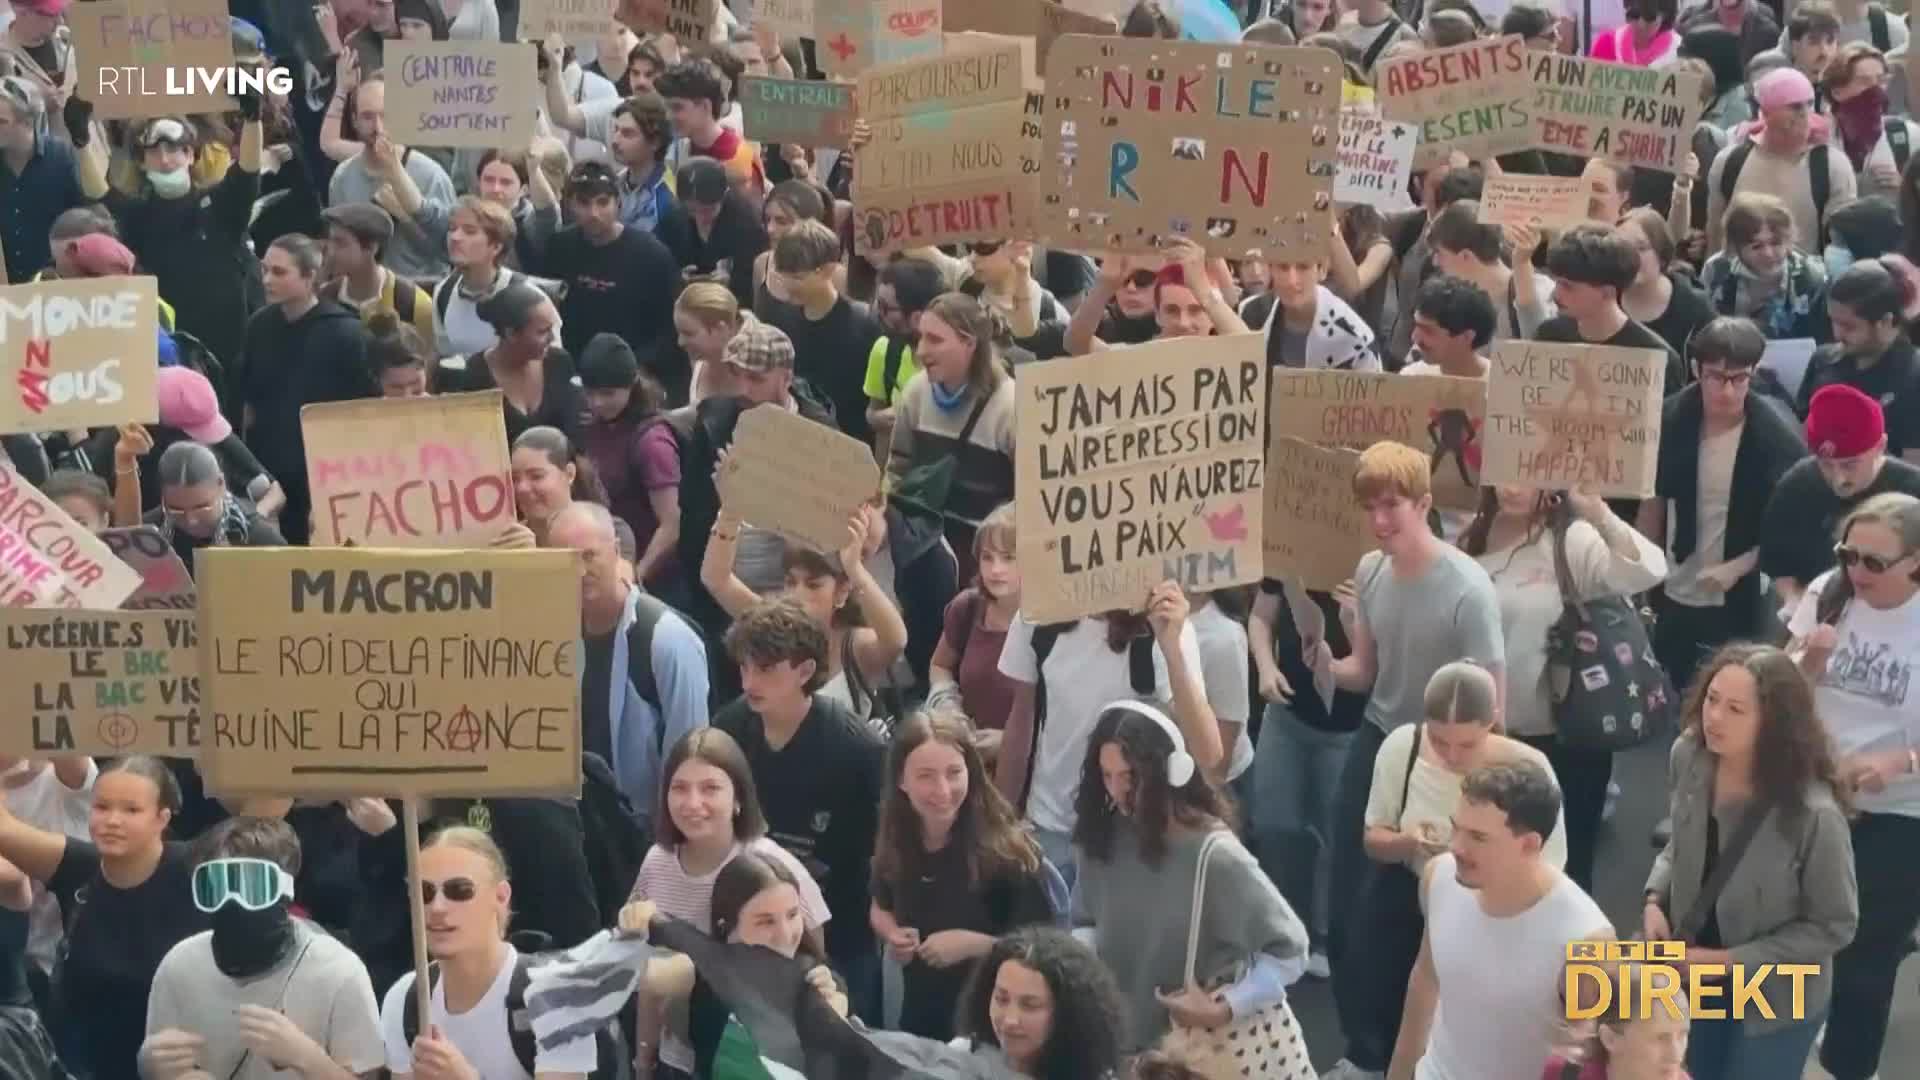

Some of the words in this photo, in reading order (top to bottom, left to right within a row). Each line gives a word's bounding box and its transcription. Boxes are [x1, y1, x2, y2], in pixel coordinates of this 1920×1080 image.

[101, 15, 223, 47] FACHOS
[402, 54, 497, 87] CENTRALE
[1387, 40, 1523, 97] ABSENTS
[1558, 59, 1585, 87] UN
[1589, 66, 1658, 94] AVENIR
[1662, 74, 1676, 99] A
[433, 86, 498, 105] NANTES
[1621, 96, 1657, 123] PAS
[1660, 103, 1685, 128] UN
[417, 114, 512, 132] SOUTIENT
[1422, 99, 1529, 143] ESENTS
[1594, 126, 1610, 154] A
[0, 291, 142, 344] MONDE
[18, 359, 124, 414] OUS
[1193, 361, 1258, 411] PAR
[1520, 385, 1551, 409] BE
[1606, 394, 1642, 414] IN
[1321, 404, 1412, 440] GRANDS
[1487, 412, 1536, 437] THE
[1082, 409, 1257, 472] RÉPRESSION
[1566, 438, 1592, 453] IT
[1516, 449, 1625, 483] HAPPENS
[1040, 477, 1135, 527] VOUS
[1150, 458, 1262, 505] N'AUREZ
[1060, 530, 1104, 575] LA
[290, 567, 493, 614] MACRON
[70, 650, 107, 678] LE
[124, 650, 169, 676] BAC
[214, 636, 260, 675] LE
[279, 633, 333, 677] ROI
[33, 681, 75, 711] LA
[95, 680, 147, 709] BAC
[355, 679, 417, 712] QUI
[32, 714, 76, 751] LA
[213, 707, 323, 751] RUINE
[338, 711, 381, 751] LA
[396, 702, 570, 754] FRANCE
